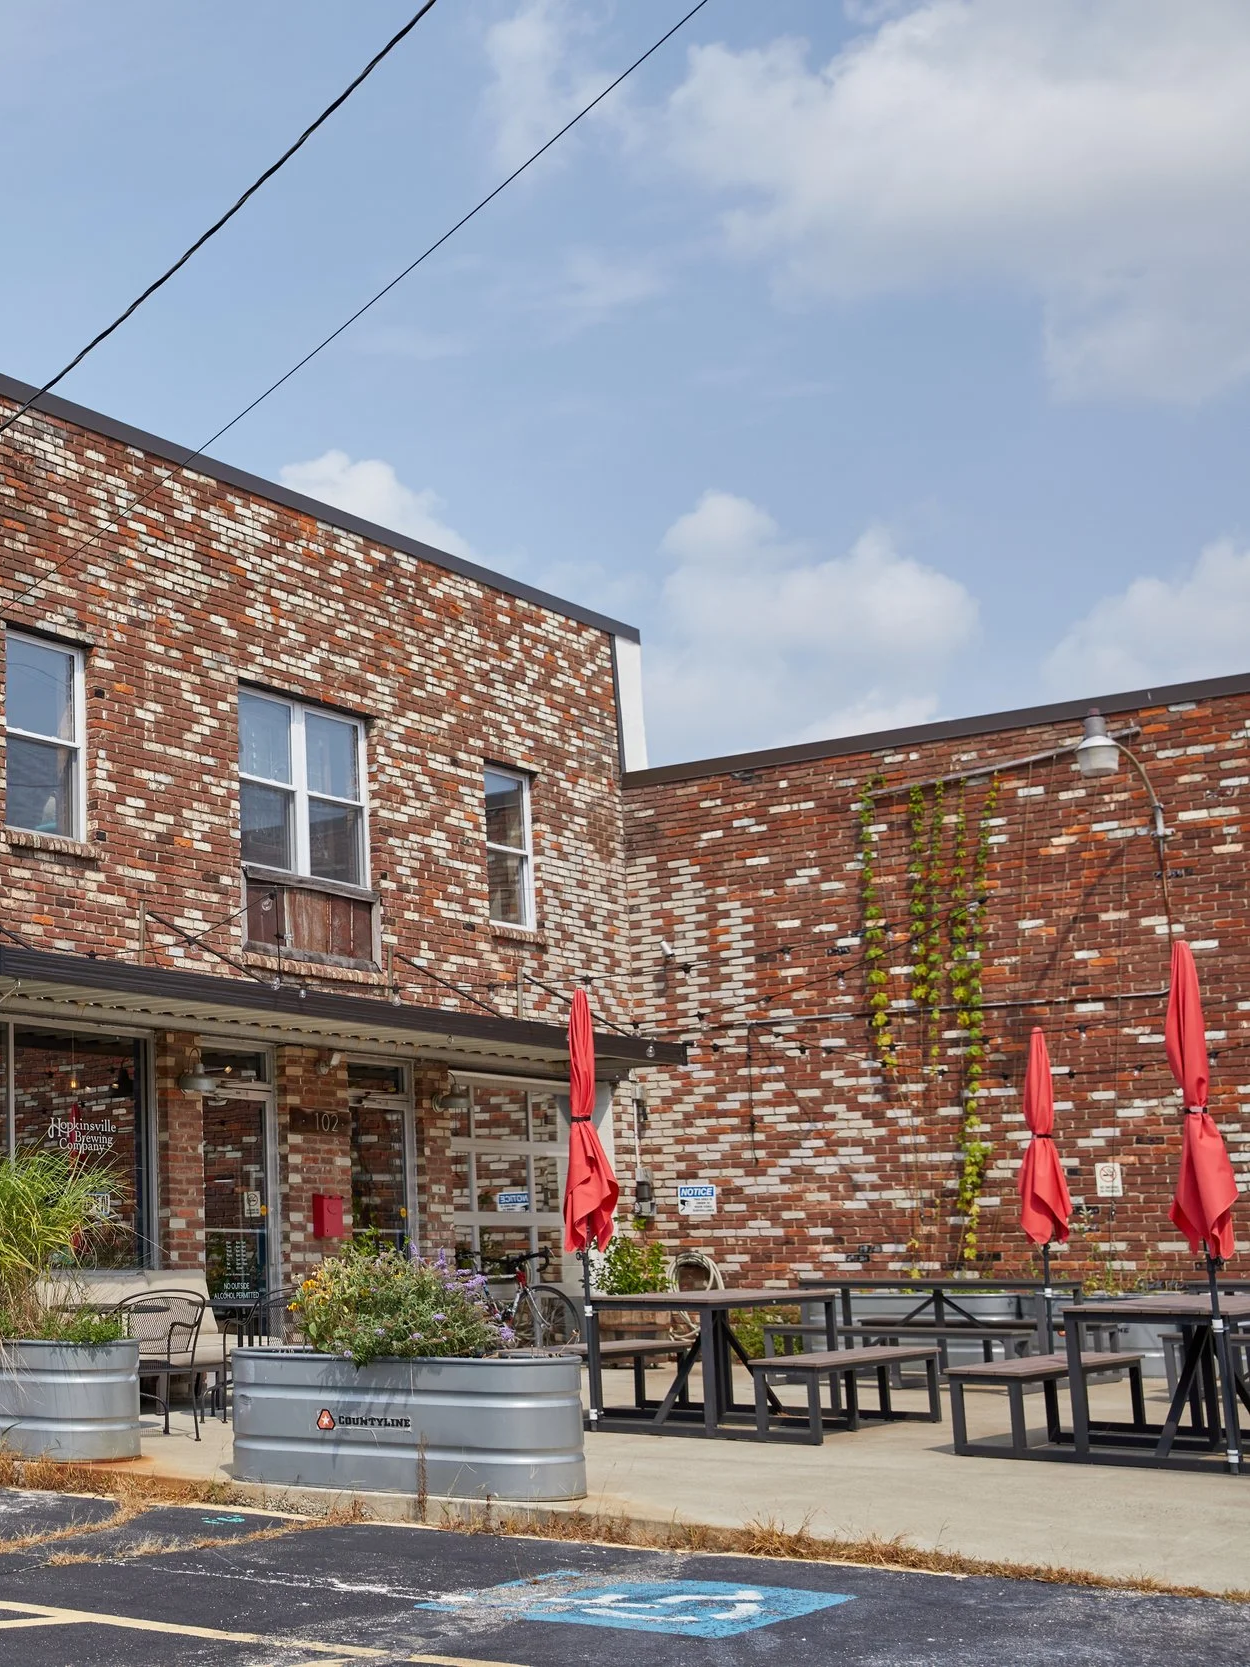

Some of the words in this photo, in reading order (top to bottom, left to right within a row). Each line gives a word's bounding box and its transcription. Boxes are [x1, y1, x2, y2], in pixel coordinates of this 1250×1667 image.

[48, 1117, 117, 1139] Hopkinsville
[315, 1112, 339, 1132] 102
[59, 1137, 106, 1155] Company
[74, 1131, 114, 1147] Brewing
[681, 1187, 713, 1196] NOTICE
[213, 1292, 236, 1300] ALCOHOL
[236, 1291, 260, 1299] PERMITTED
[338, 1415, 411, 1428] COUNTYLINE
